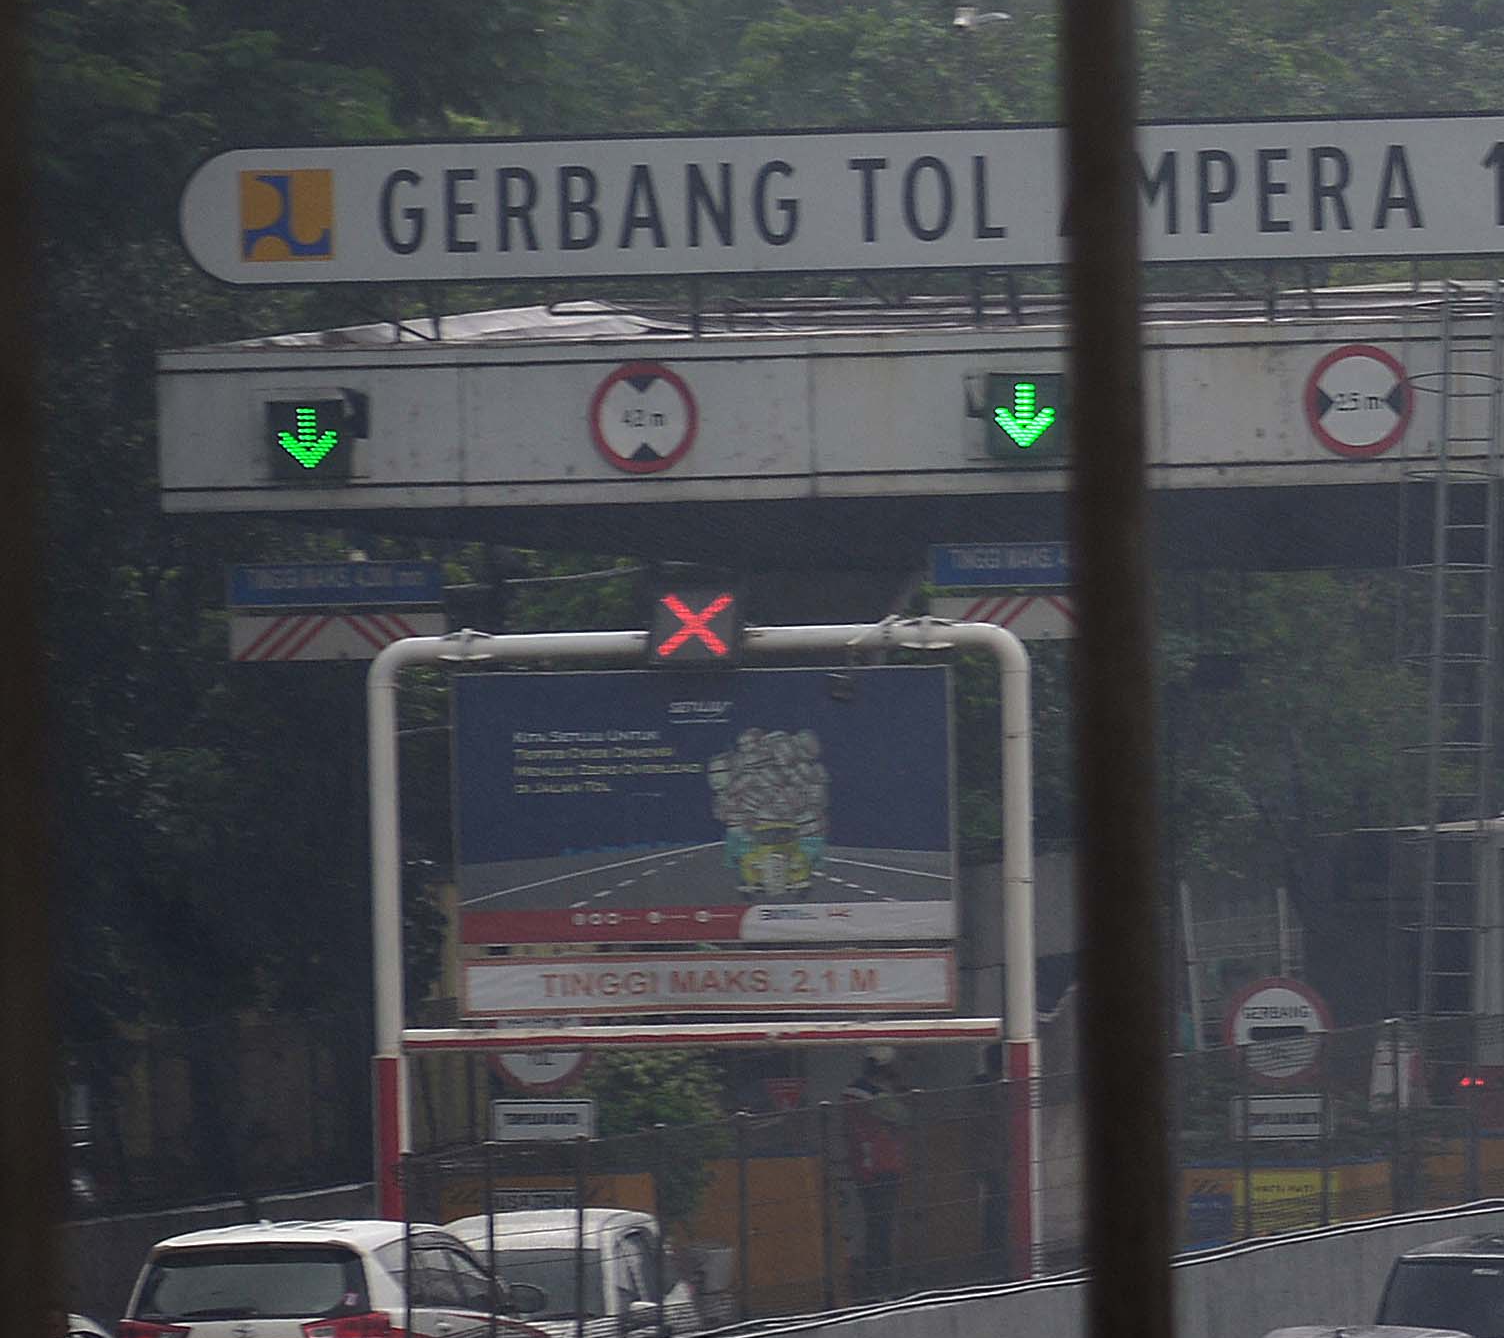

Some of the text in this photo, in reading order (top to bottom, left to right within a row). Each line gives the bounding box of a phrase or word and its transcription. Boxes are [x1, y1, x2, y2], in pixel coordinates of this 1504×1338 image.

[380, 161, 798, 255] GERBANG
[849, 155, 1007, 243] TOL
[1057, 144, 1424, 237] MPERA
[542, 971, 659, 998] TINGGI
[671, 967, 783, 995] MAKS.
[849, 967, 879, 993] M
